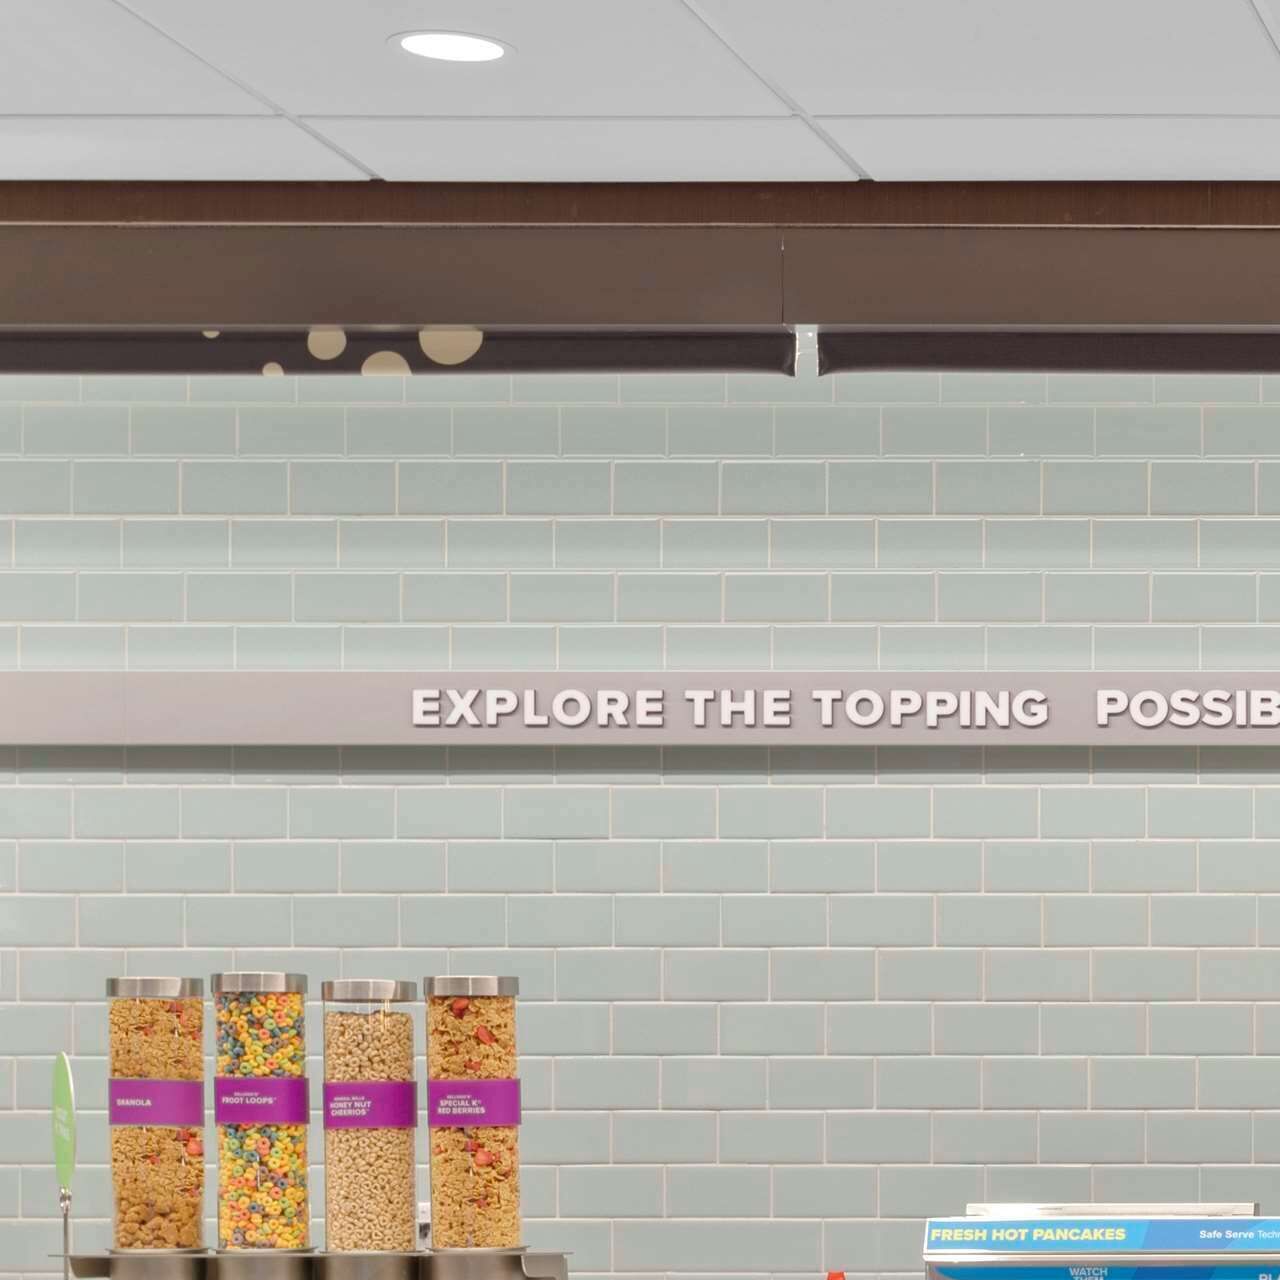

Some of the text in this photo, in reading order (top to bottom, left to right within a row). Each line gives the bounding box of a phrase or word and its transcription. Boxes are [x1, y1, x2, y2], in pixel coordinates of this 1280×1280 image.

[412, 689, 664, 726] EXPLORE
[685, 689, 792, 726] THE
[812, 689, 1048, 728] TOPPING
[930, 1228, 1127, 1241] FRESH HOT PANCAKES
[1199, 1230, 1223, 1239] Safe
[1225, 1230, 1255, 1239] Serve
[1069, 1267, 1108, 1277] WATCH
